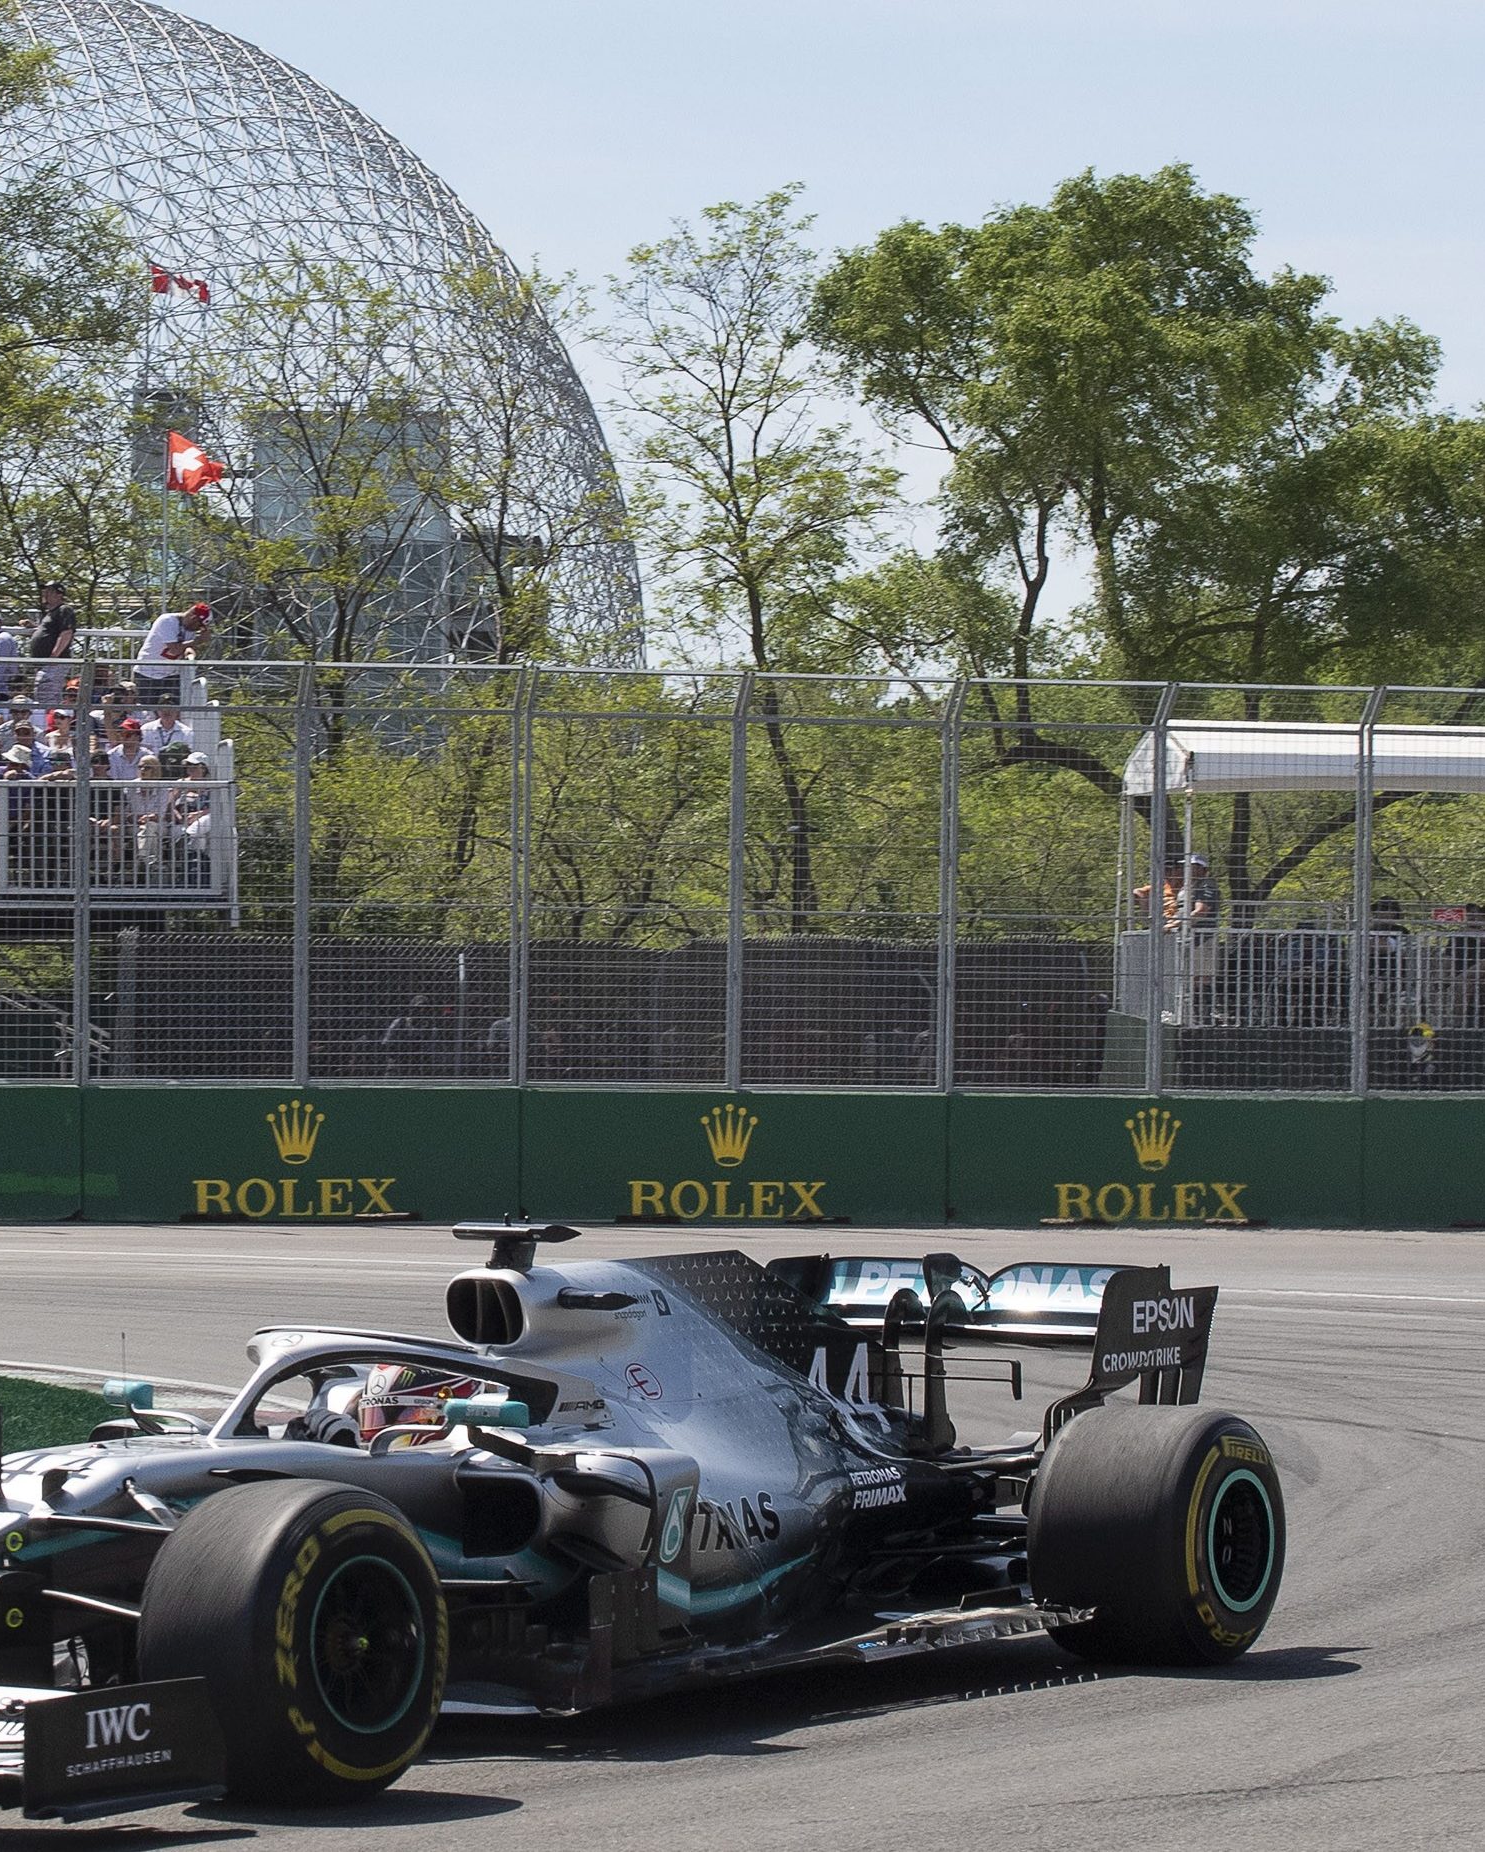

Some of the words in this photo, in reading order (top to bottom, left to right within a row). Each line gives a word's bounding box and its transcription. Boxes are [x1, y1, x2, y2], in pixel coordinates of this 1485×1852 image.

[193, 1178, 396, 1217] ROLEX
[628, 1181, 827, 1219] ROLEX
[1054, 1183, 1247, 1222] ROLEX
[1132, 1296, 1195, 1334] EPSON
[1102, 1346, 1181, 1373] CROWDSTRIKE
[849, 1466, 901, 1487] PETRONAS
[852, 1482, 907, 1510] PRIMAX
[84, 1703, 152, 1749] IWC
[66, 1750, 173, 1778] SCHAFFHAUSEN
